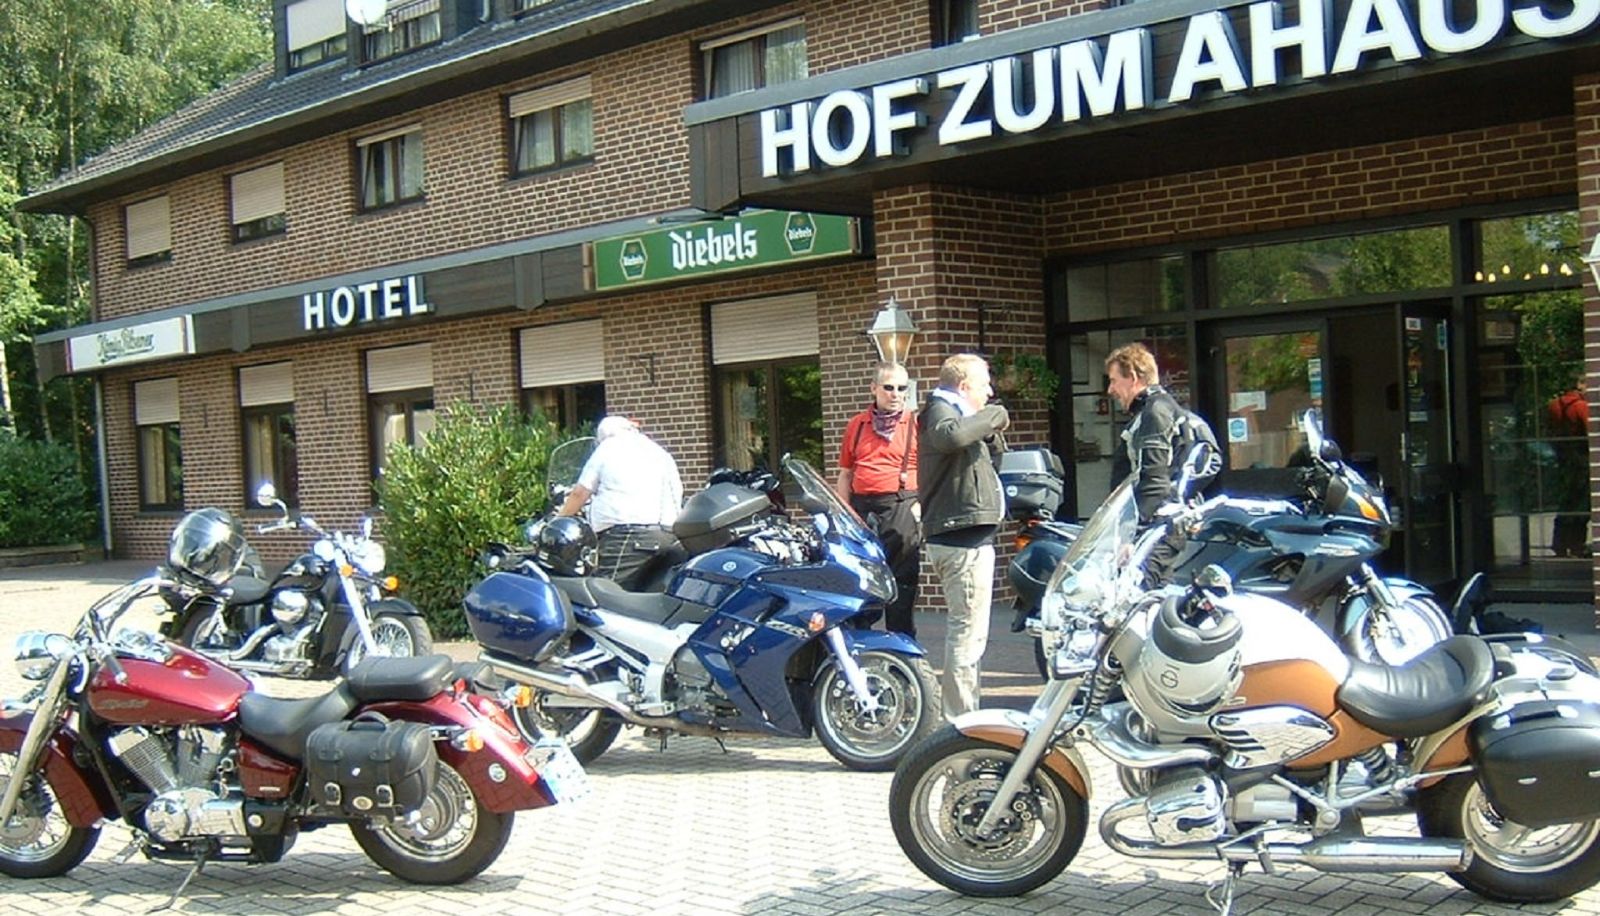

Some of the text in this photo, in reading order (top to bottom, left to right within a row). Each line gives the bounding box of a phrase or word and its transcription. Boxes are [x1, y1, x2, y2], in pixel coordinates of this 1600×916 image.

[760, 78, 925, 178] HOF
[937, 28, 1147, 146] ZUM
[668, 222, 758, 270] Diebels
[303, 275, 428, 331] HOTEL
